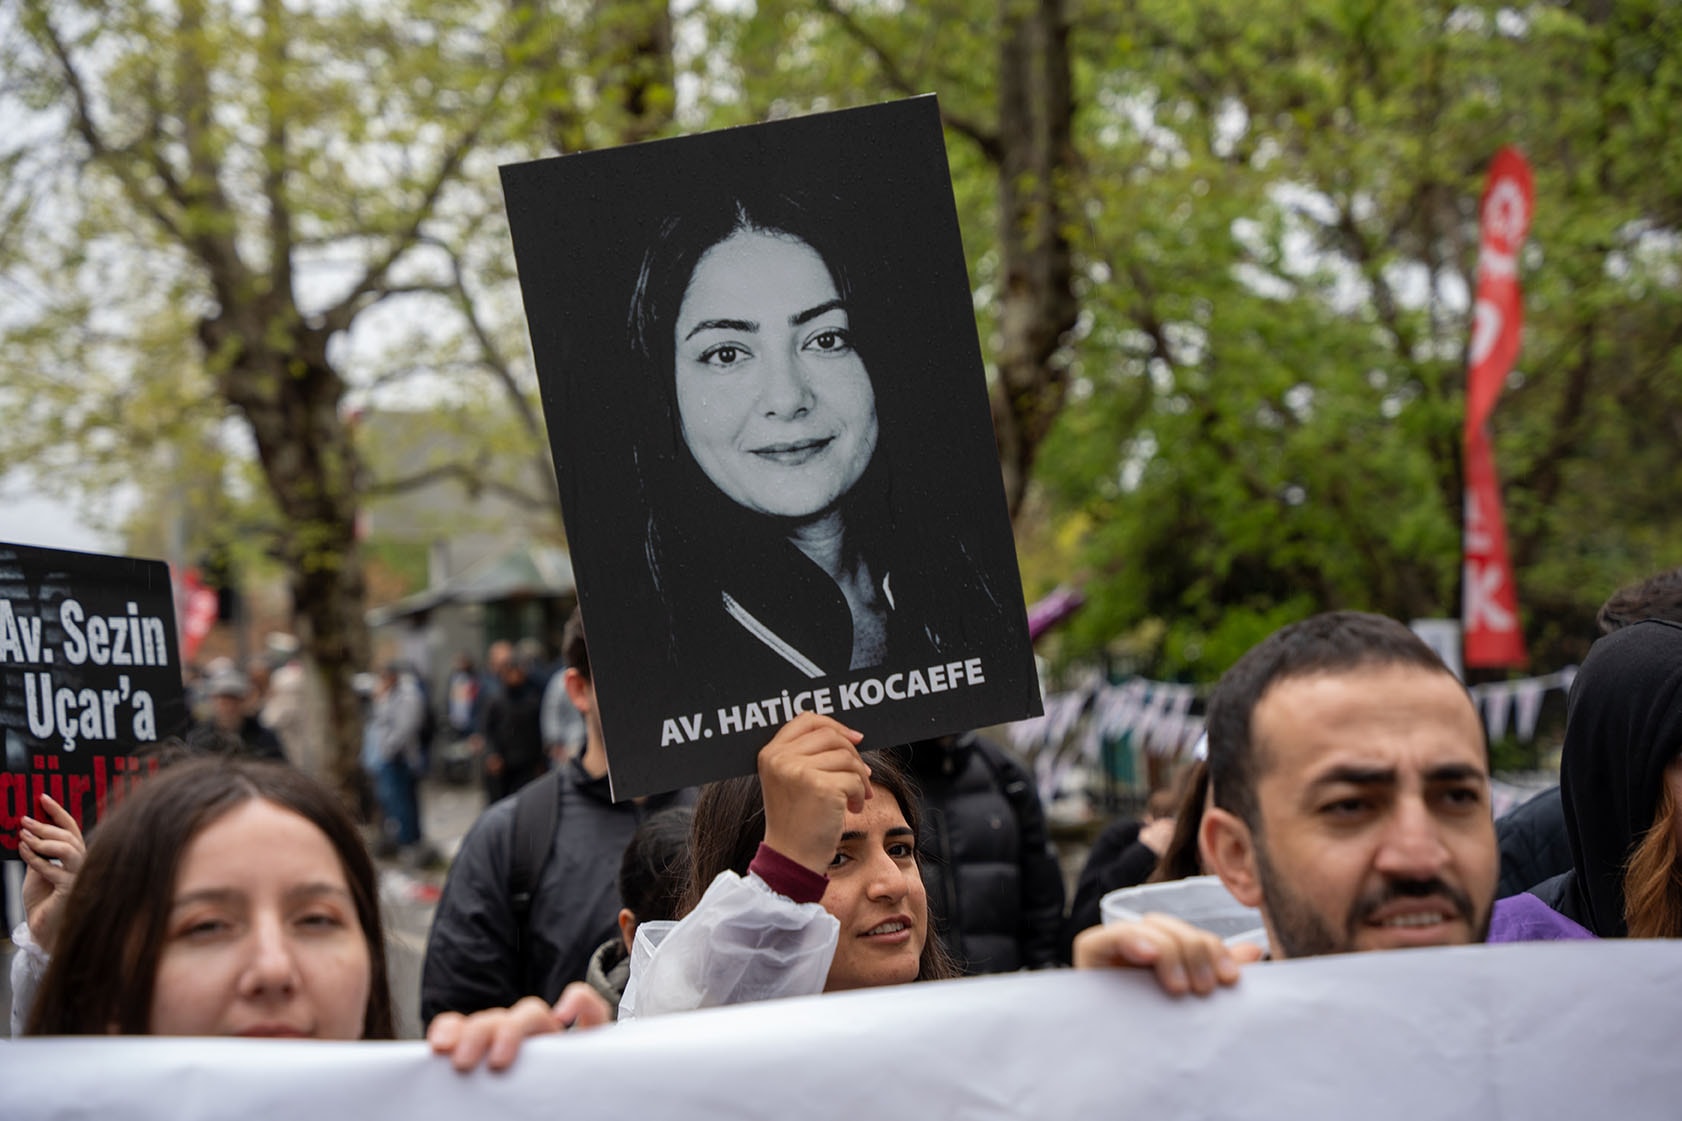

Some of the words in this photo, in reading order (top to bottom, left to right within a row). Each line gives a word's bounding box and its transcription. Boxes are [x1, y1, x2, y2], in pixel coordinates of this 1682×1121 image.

[0, 599, 54, 663] Av.
[60, 599, 168, 666] Sezin
[24, 672, 156, 752] Uçar'a
[660, 713, 713, 747] AV.
[718, 687, 834, 735] HATİCE
[838, 657, 985, 711] KOCAEFE
